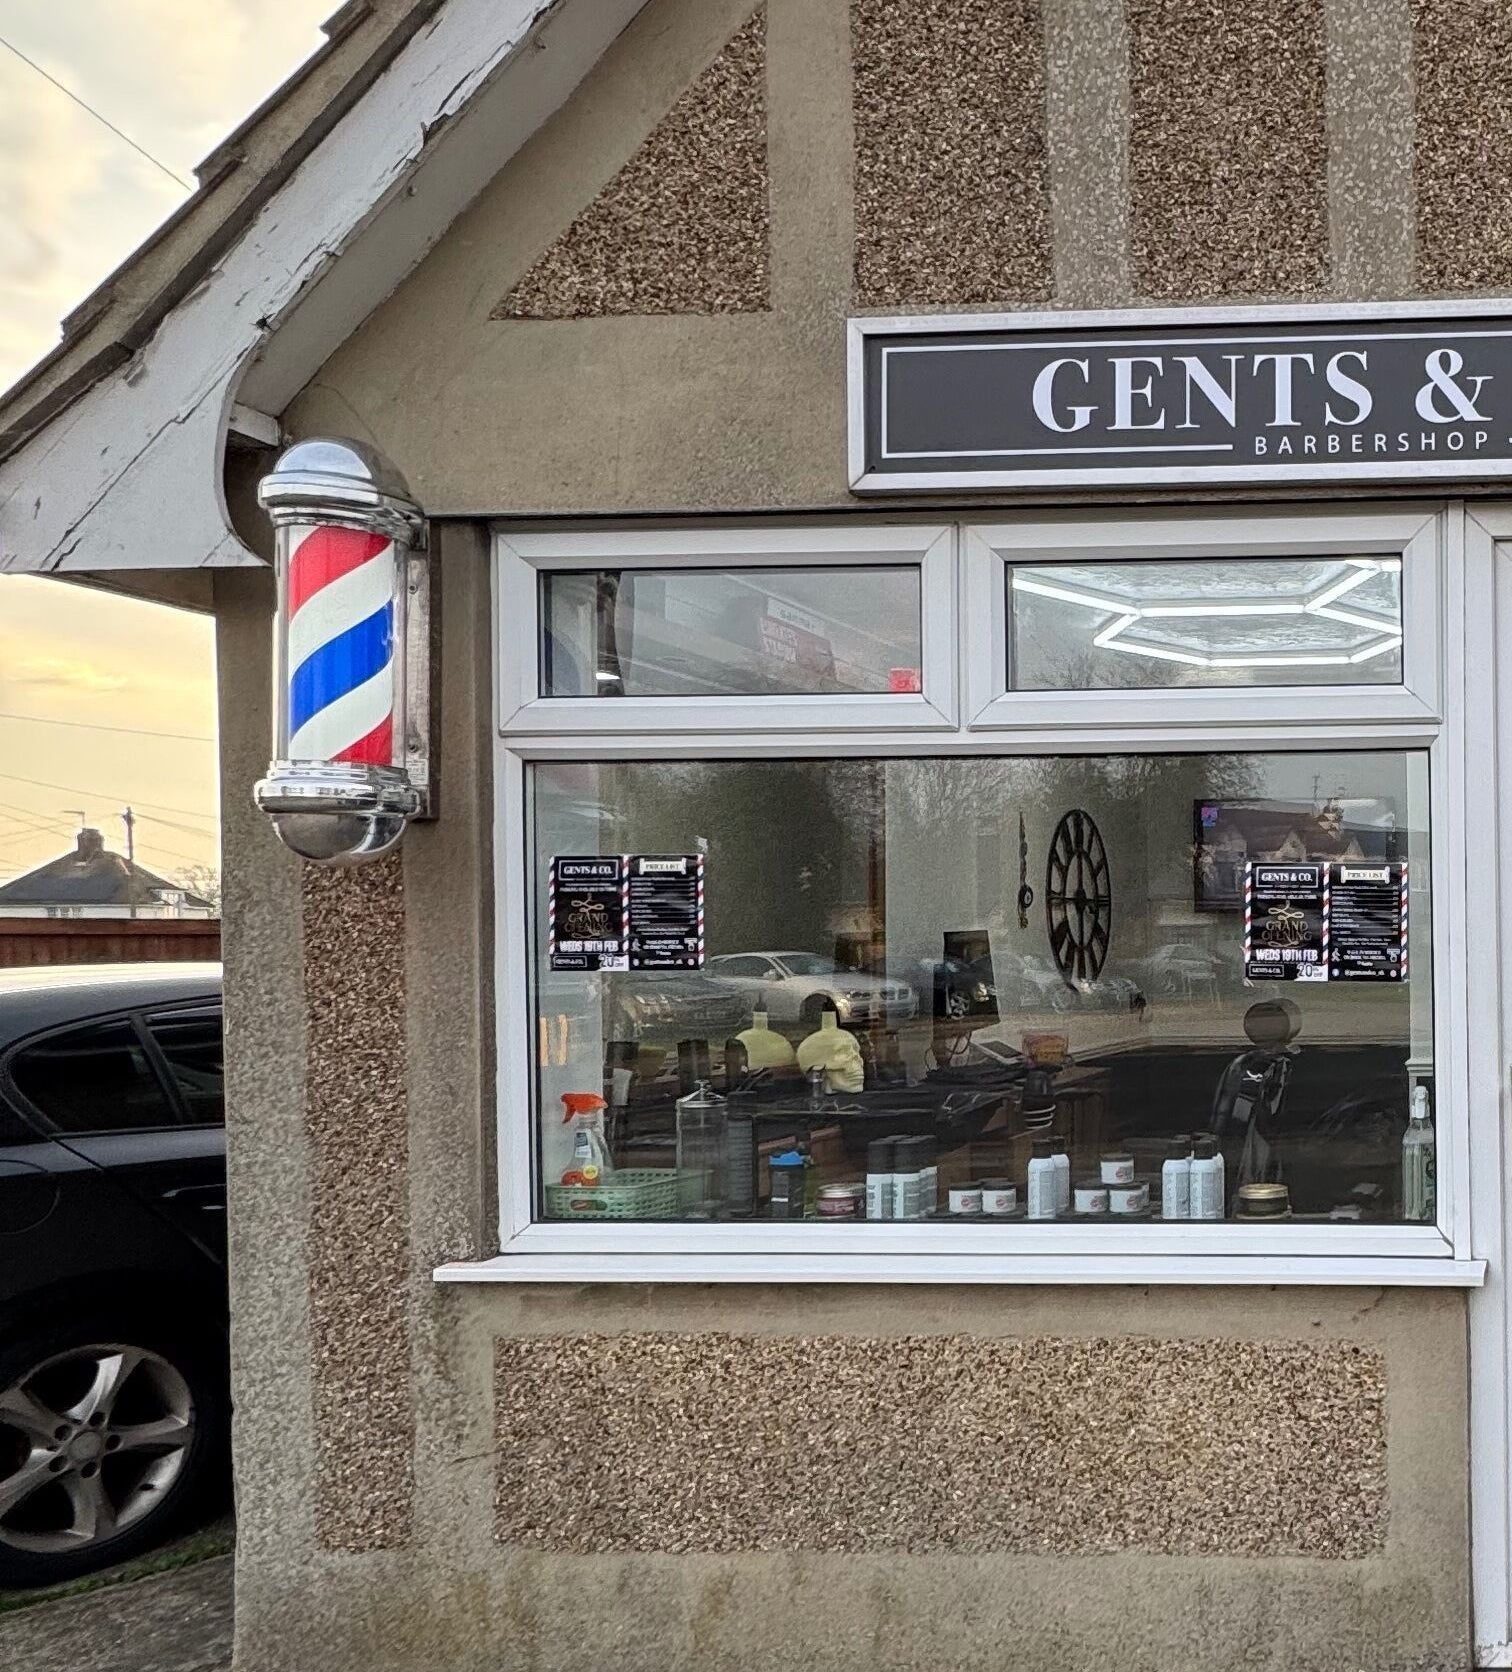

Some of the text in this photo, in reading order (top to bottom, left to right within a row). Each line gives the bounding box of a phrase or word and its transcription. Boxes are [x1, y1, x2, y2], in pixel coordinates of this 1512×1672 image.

[1032, 351, 1373, 433] GENTS
[1415, 348, 1494, 424] &
[1254, 431, 1492, 456] BARBERSHOP
[564, 865, 591, 875] GENTS
[599, 865, 612, 874] CO.
[1261, 872, 1313, 882] GENTS & CO.
[568, 912, 608, 923] GRAND
[1265, 921, 1309, 931] GRAND
[1261, 930, 1313, 941] OPENING
[559, 941, 582, 952] WEDS
[604, 941, 619, 952] FEB
[1255, 949, 1318, 961] WEDS 19TH FEB
[1297, 964, 1313, 978] 20
